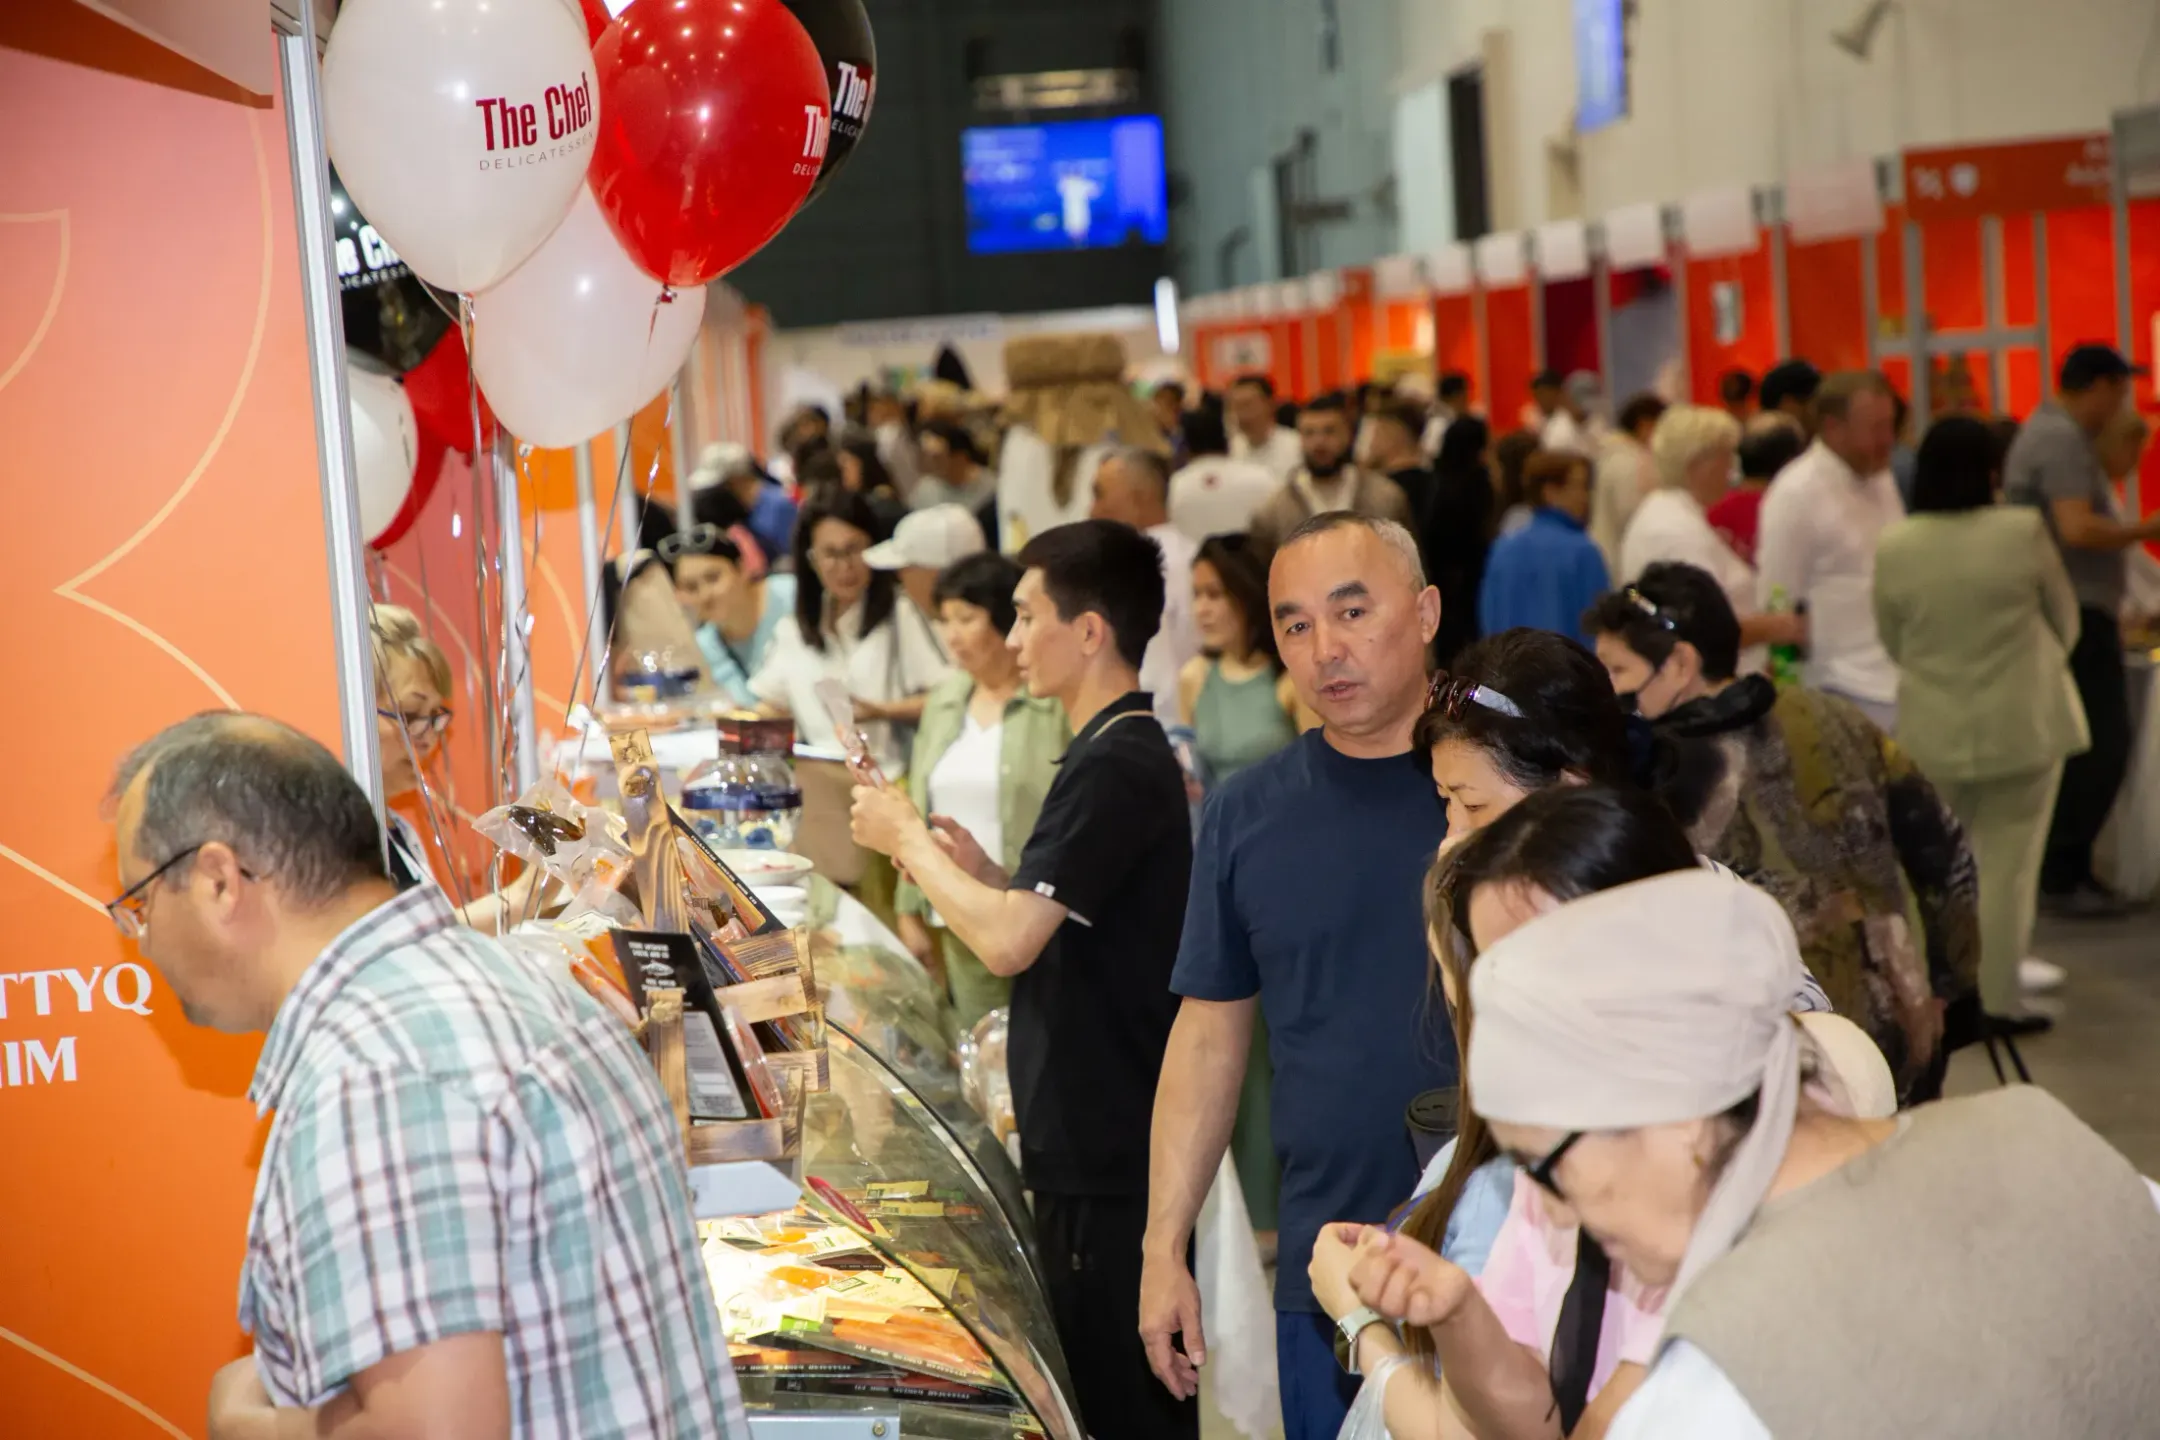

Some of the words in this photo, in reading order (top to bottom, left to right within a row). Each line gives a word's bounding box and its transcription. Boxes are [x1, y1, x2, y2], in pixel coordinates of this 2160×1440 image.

[475, 96, 538, 151] The
[544, 71, 592, 140] Chef
[833, 61, 868, 120] The
[802, 104, 830, 158] Th
[0, 1036, 78, 1089] IM
